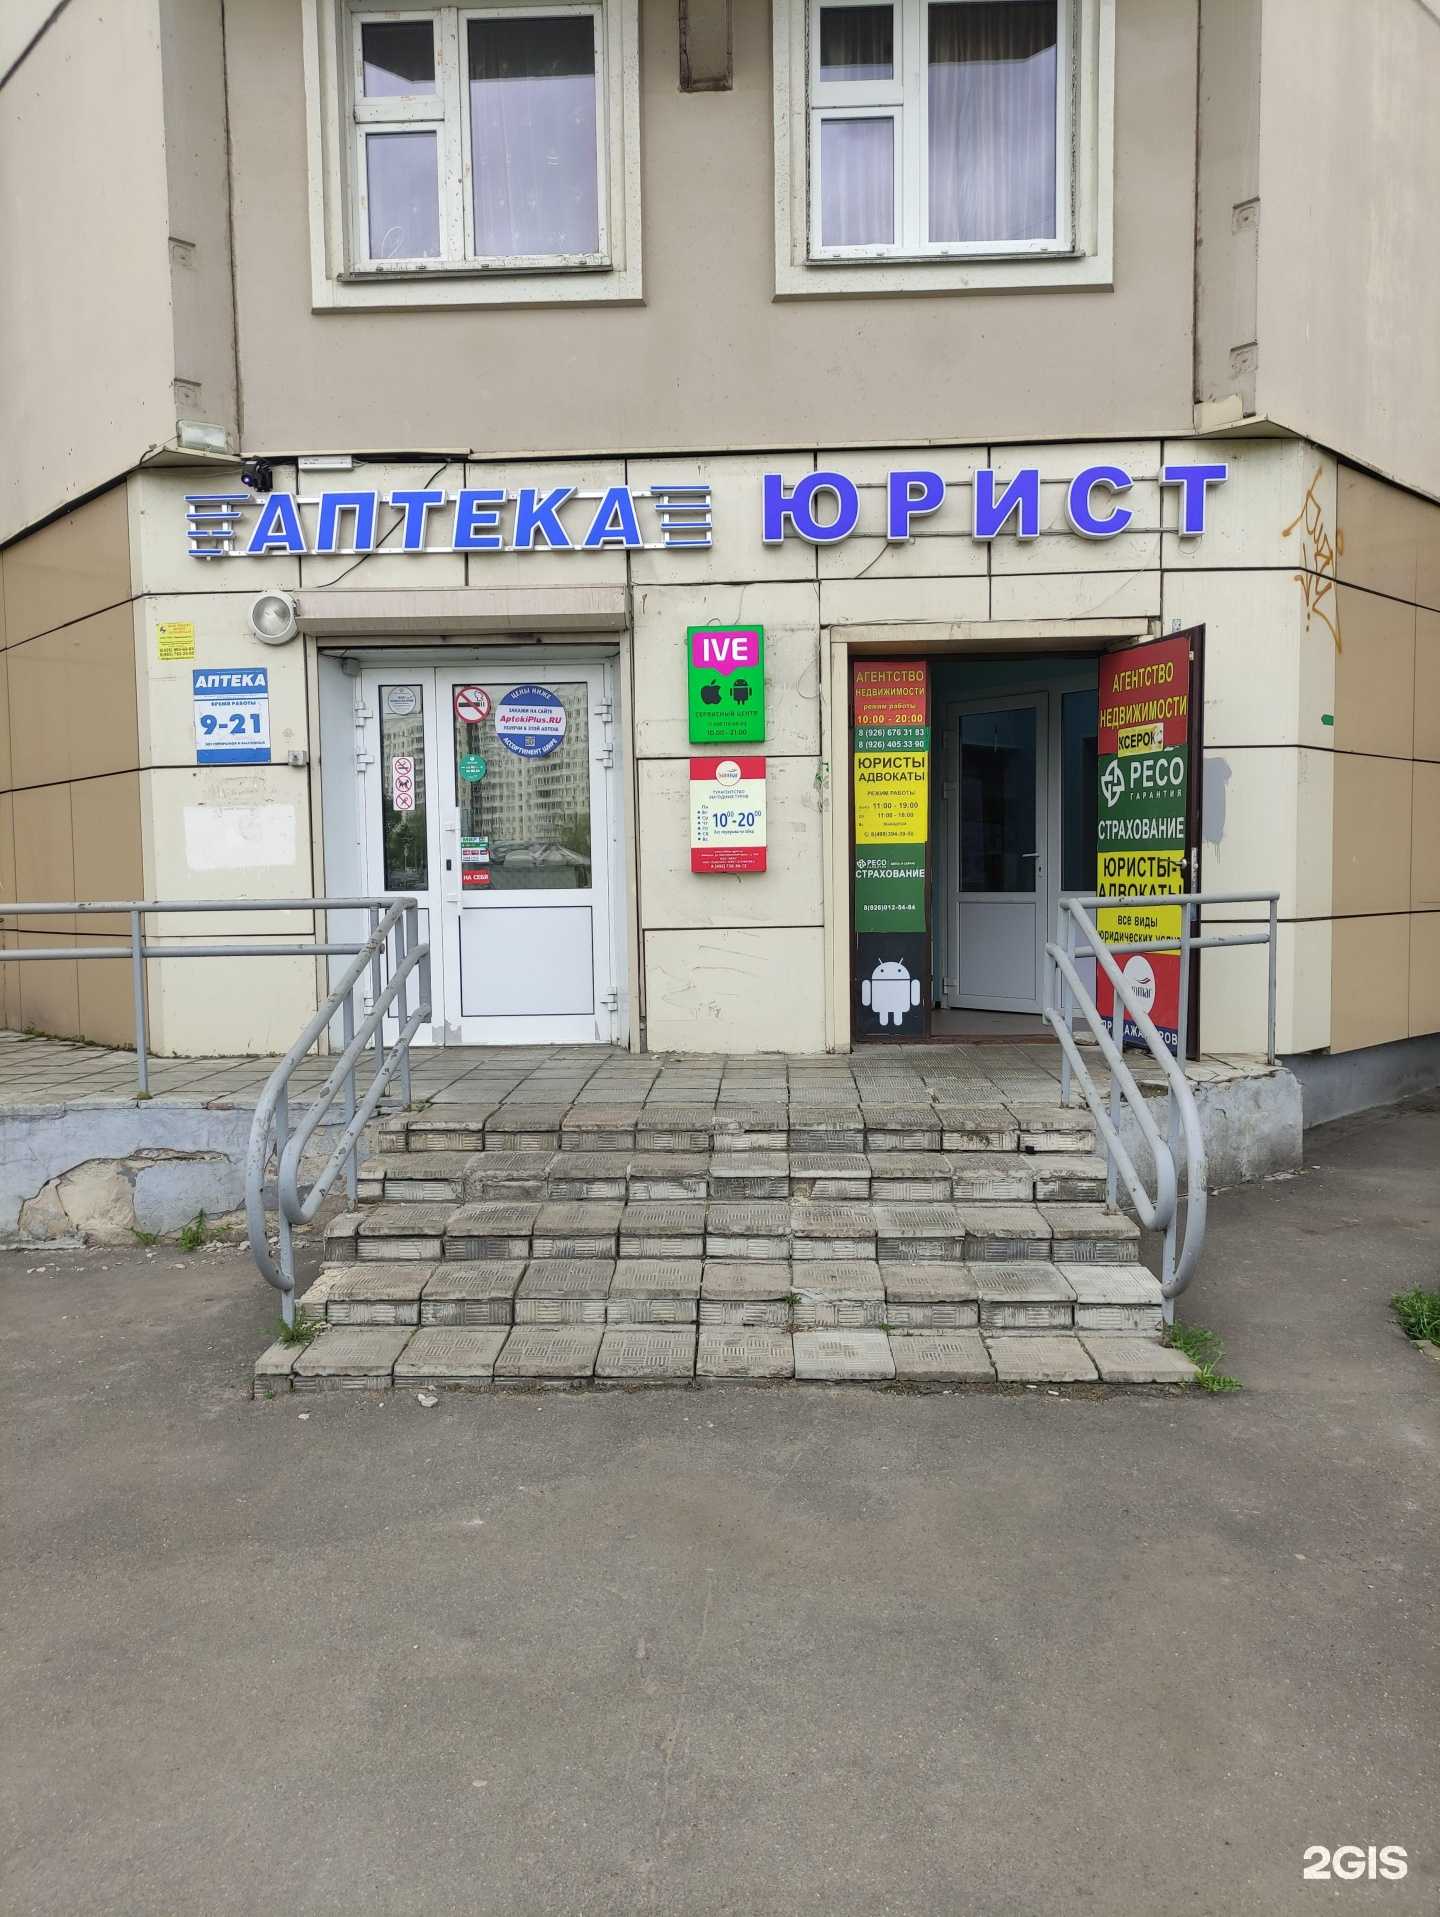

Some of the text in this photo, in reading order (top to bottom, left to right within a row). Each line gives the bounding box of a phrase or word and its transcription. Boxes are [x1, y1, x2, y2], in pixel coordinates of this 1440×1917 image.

[761, 463, 1228, 546] ЮРИСТ
[247, 485, 643, 555] АПТЕКА
[703, 637, 748, 661] IVE
[195, 674, 265, 688] АПТЕКА
[856, 670, 924, 682] АГЕНТСТВО
[1112, 661, 1174, 693] АГЕНТСТВО
[856, 687, 925, 697] НЕДВИЖИМОСТИ
[858, 715, 885, 724] 10:00
[895, 714, 923, 723] 20:00
[1100, 695, 1188, 730] НЕДВИЖИМОСТИ
[200, 713, 261, 735] 9-21
[1118, 729, 1162, 750] КСЕРОК
[858, 757, 925, 769] ЮРИСТЫ
[858, 771, 925, 783] АДВОКАТЫ
[1130, 756, 1185, 789] РЕСО
[1130, 789, 1182, 801] ГАРАНТИЯ
[1098, 817, 1185, 840] СТРАХОВАНИЕ
[855, 868, 925, 879] СТРАХОВАНИЕ
[1117, 915, 1158, 929] все виды
